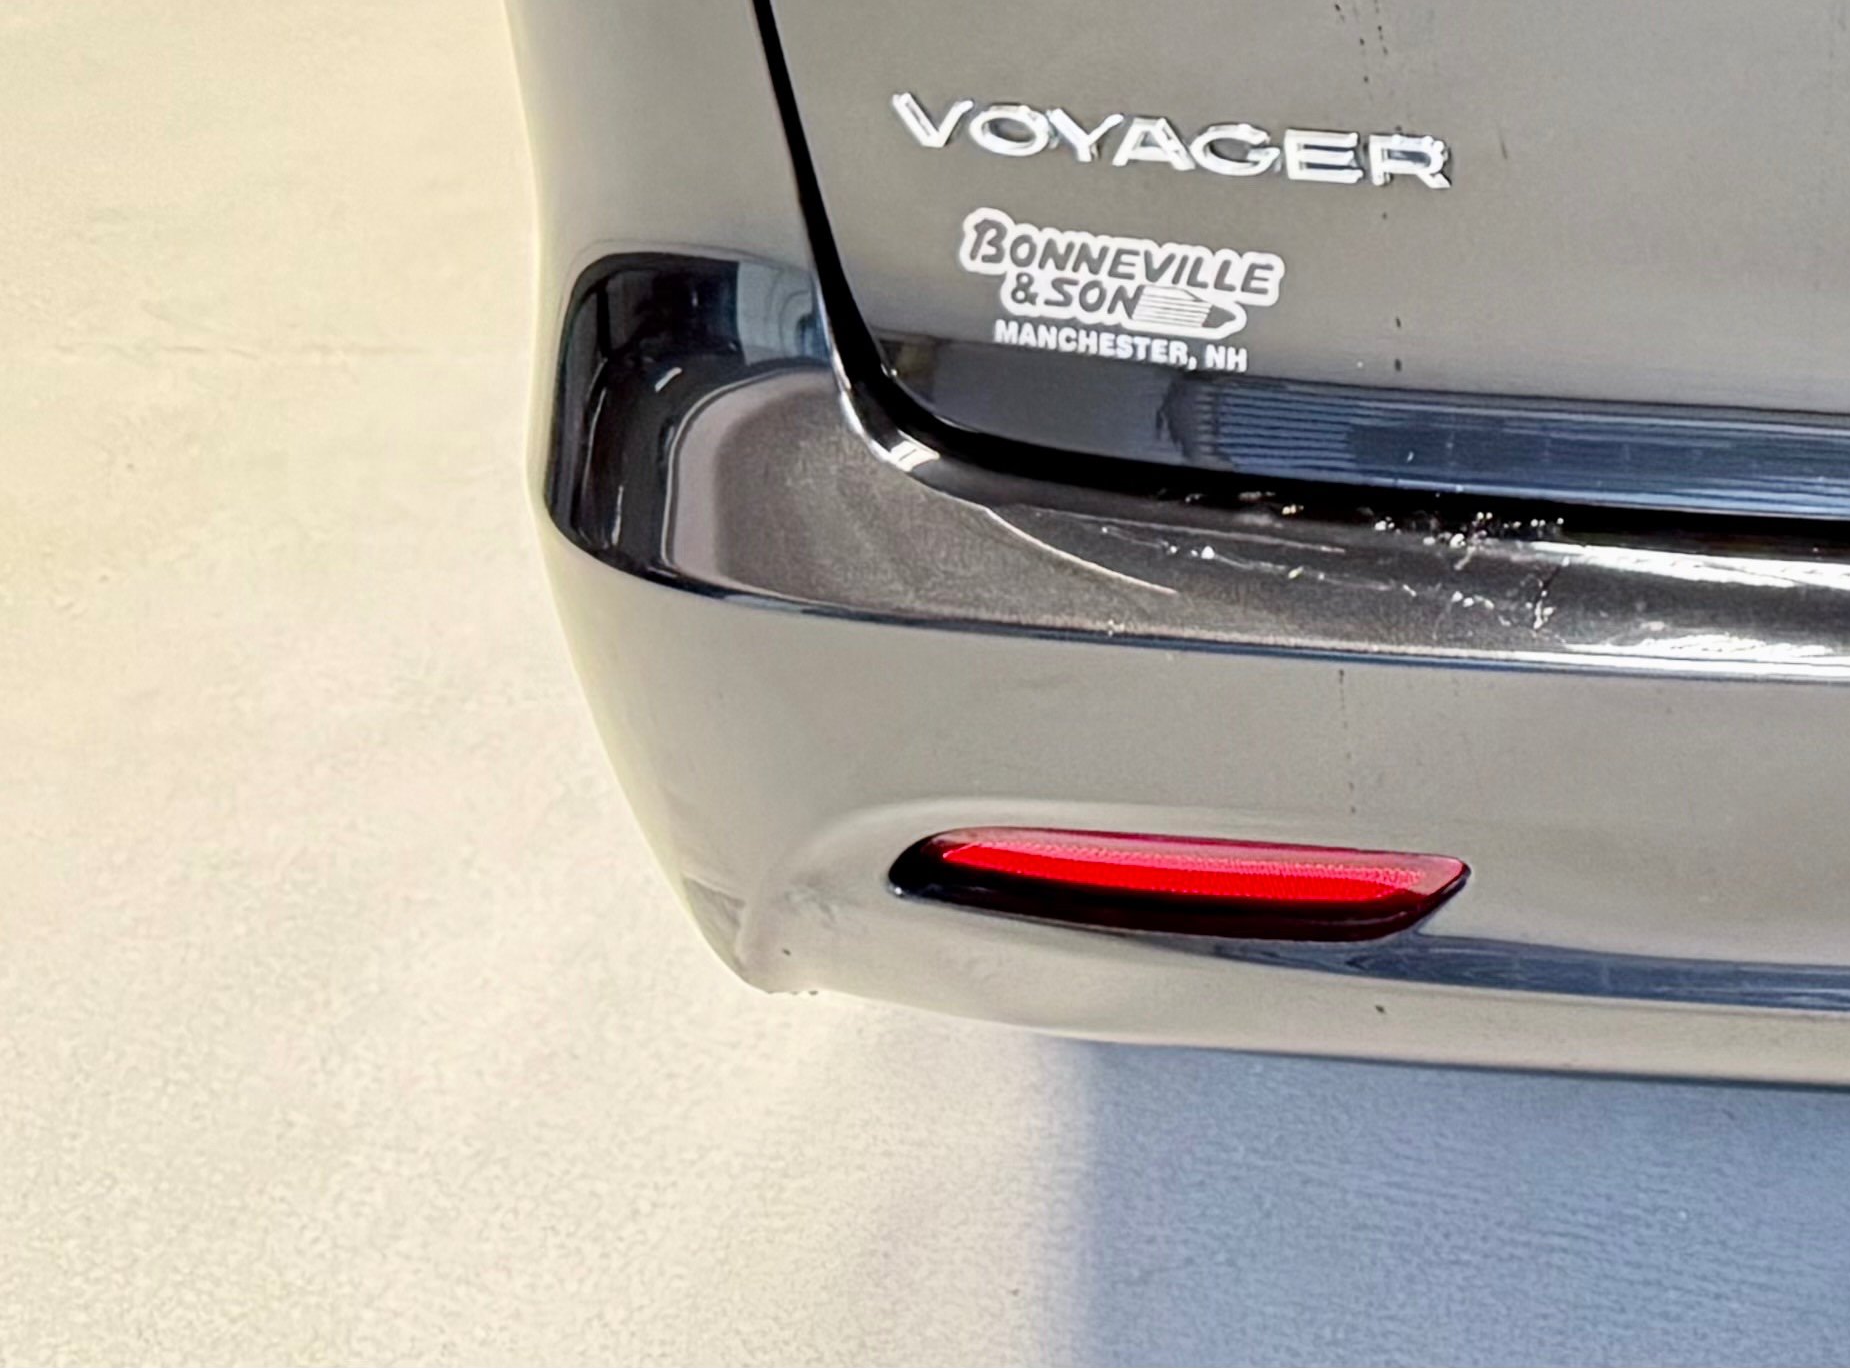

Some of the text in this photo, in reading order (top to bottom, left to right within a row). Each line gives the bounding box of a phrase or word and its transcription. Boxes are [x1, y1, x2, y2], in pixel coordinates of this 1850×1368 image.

[893, 91, 1452, 189] VOYAGER
[969, 218, 1275, 295] BONNEVILLE
[994, 319, 1248, 373] MANCHESTER, NH
